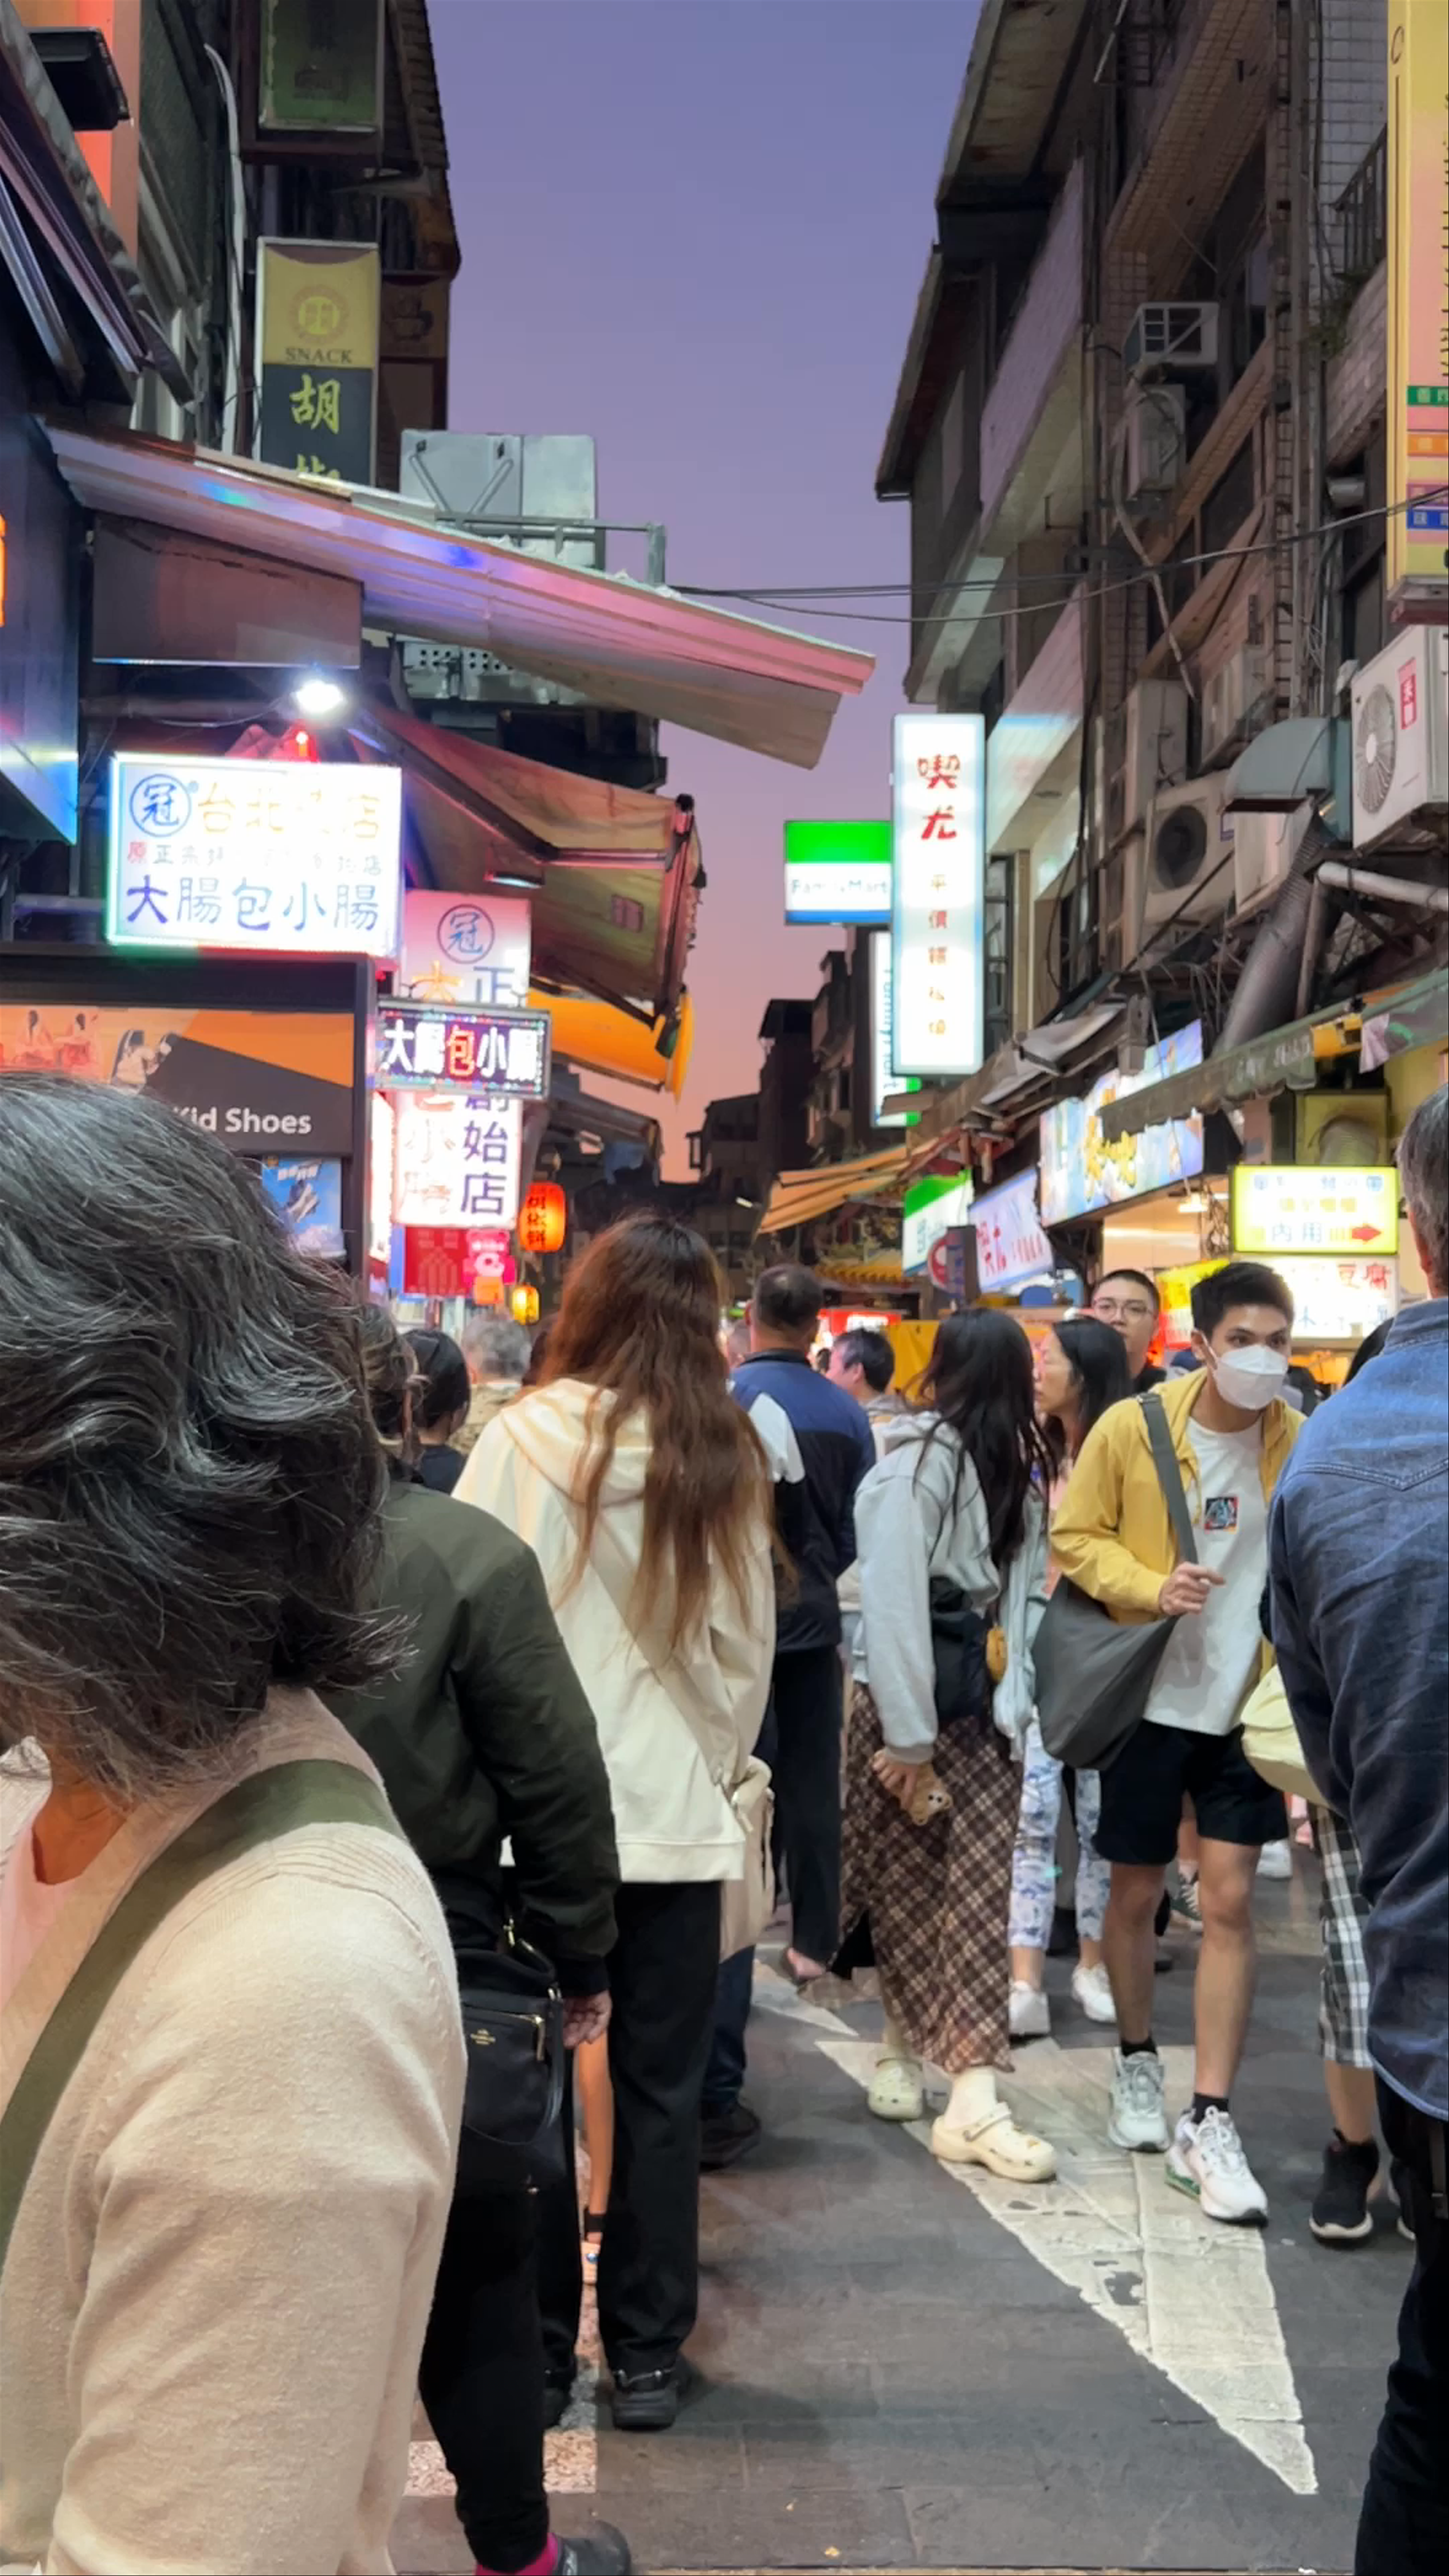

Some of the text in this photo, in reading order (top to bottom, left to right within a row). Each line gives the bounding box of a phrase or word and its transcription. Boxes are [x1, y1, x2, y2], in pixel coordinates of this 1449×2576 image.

[285, 347, 353, 363] SNACK
[141, 782, 180, 827] 冠
[126, 874, 379, 931] 大腸包小腸
[448, 911, 483, 954] 冠
[380, 1018, 539, 1082] 大包小
[225, 1107, 312, 1134] Shoes
